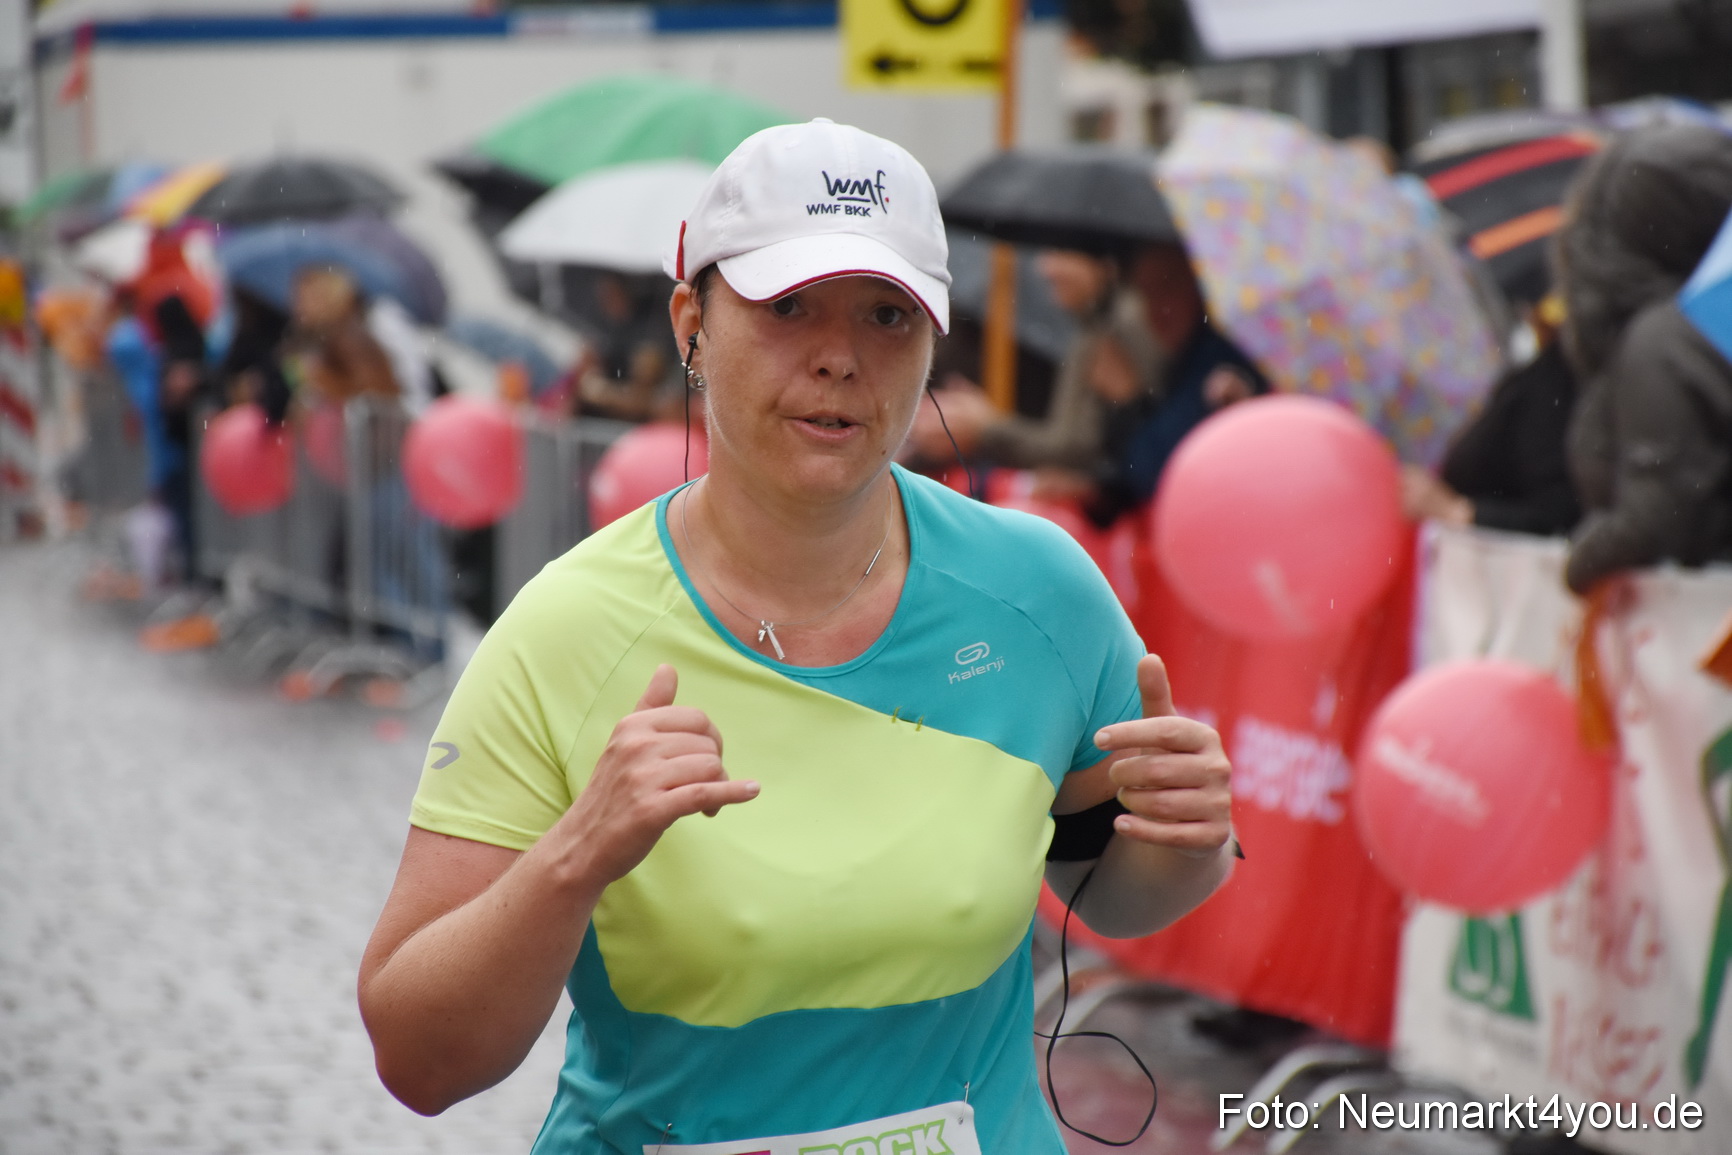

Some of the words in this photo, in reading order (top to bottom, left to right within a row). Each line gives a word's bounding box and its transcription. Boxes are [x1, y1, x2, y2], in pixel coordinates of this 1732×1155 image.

[806, 203, 841, 215] WMF
[844, 205, 872, 217] BKK
[947, 655, 1006, 685] Kalenji
